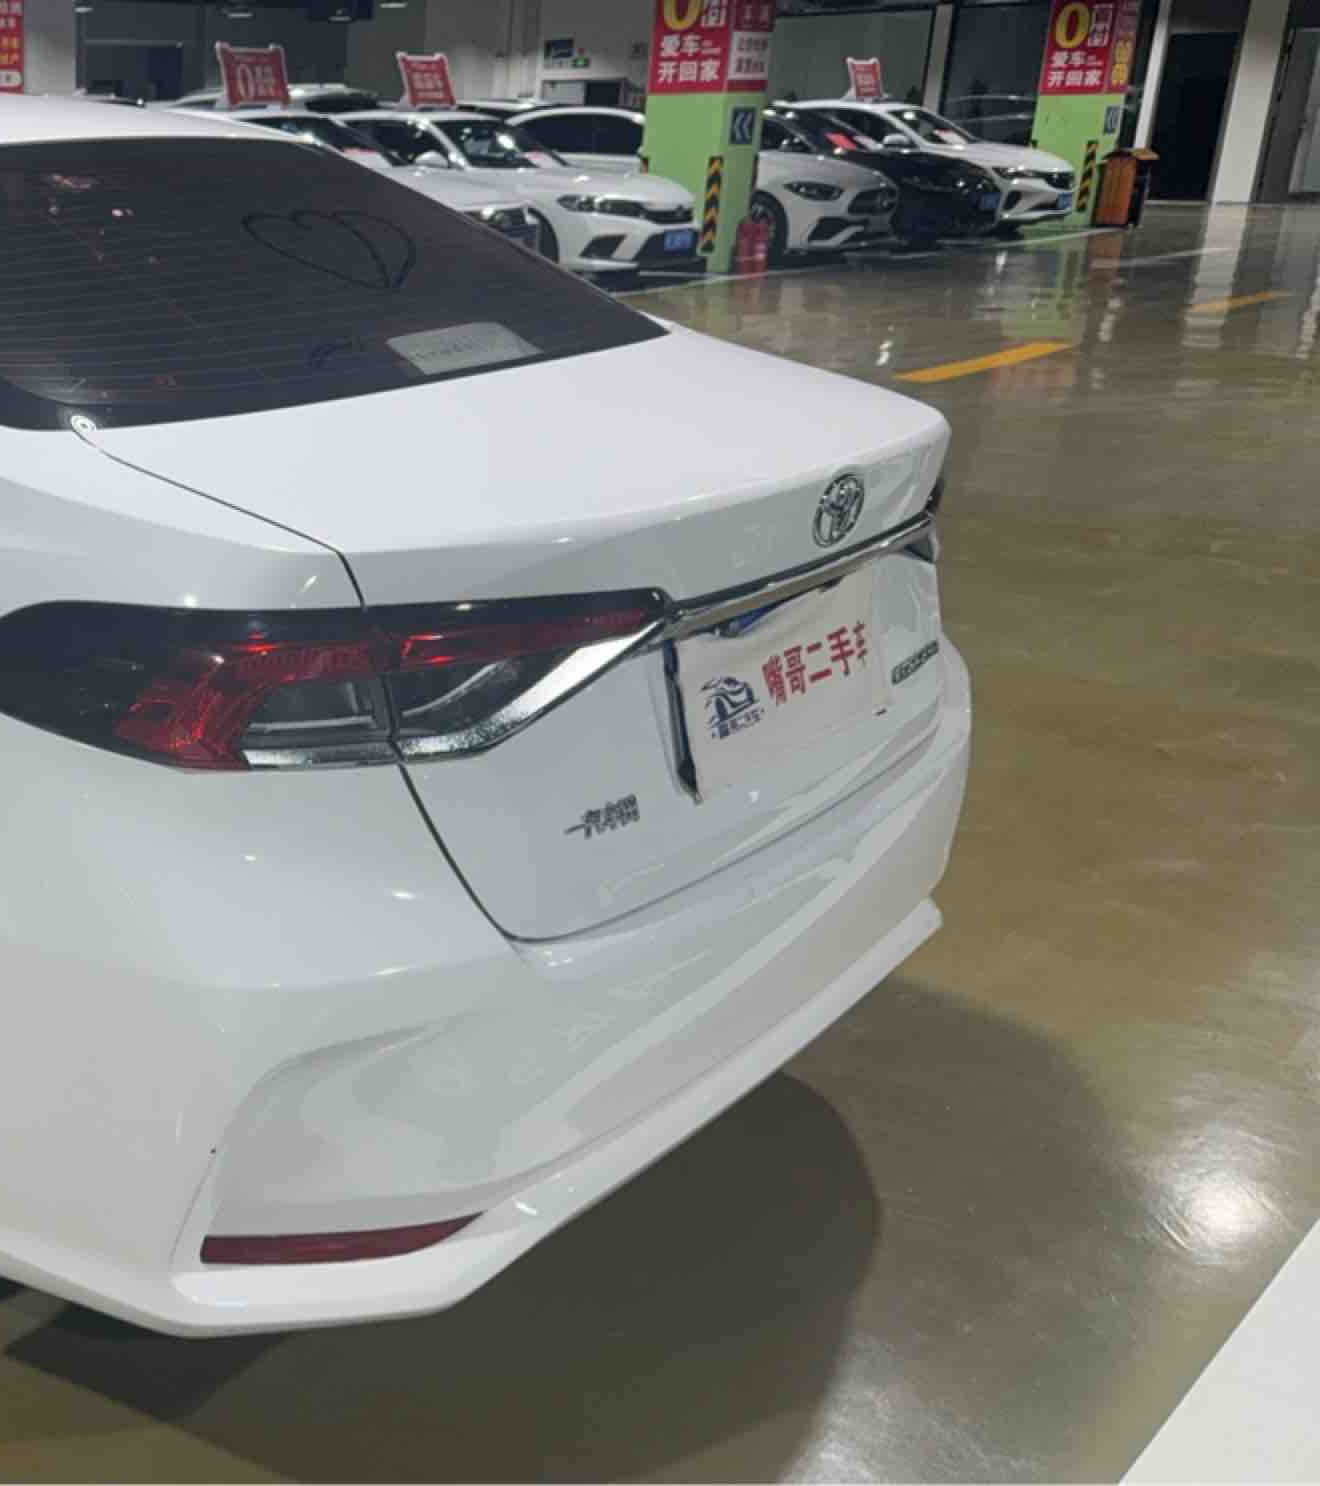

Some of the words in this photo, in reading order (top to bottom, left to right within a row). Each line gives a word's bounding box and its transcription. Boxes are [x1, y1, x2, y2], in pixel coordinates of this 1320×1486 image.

[658, 59, 722, 84] 开回家
[1048, 70, 1104, 89] 开回家
[761, 620, 868, 706] 嘴哥二手车
